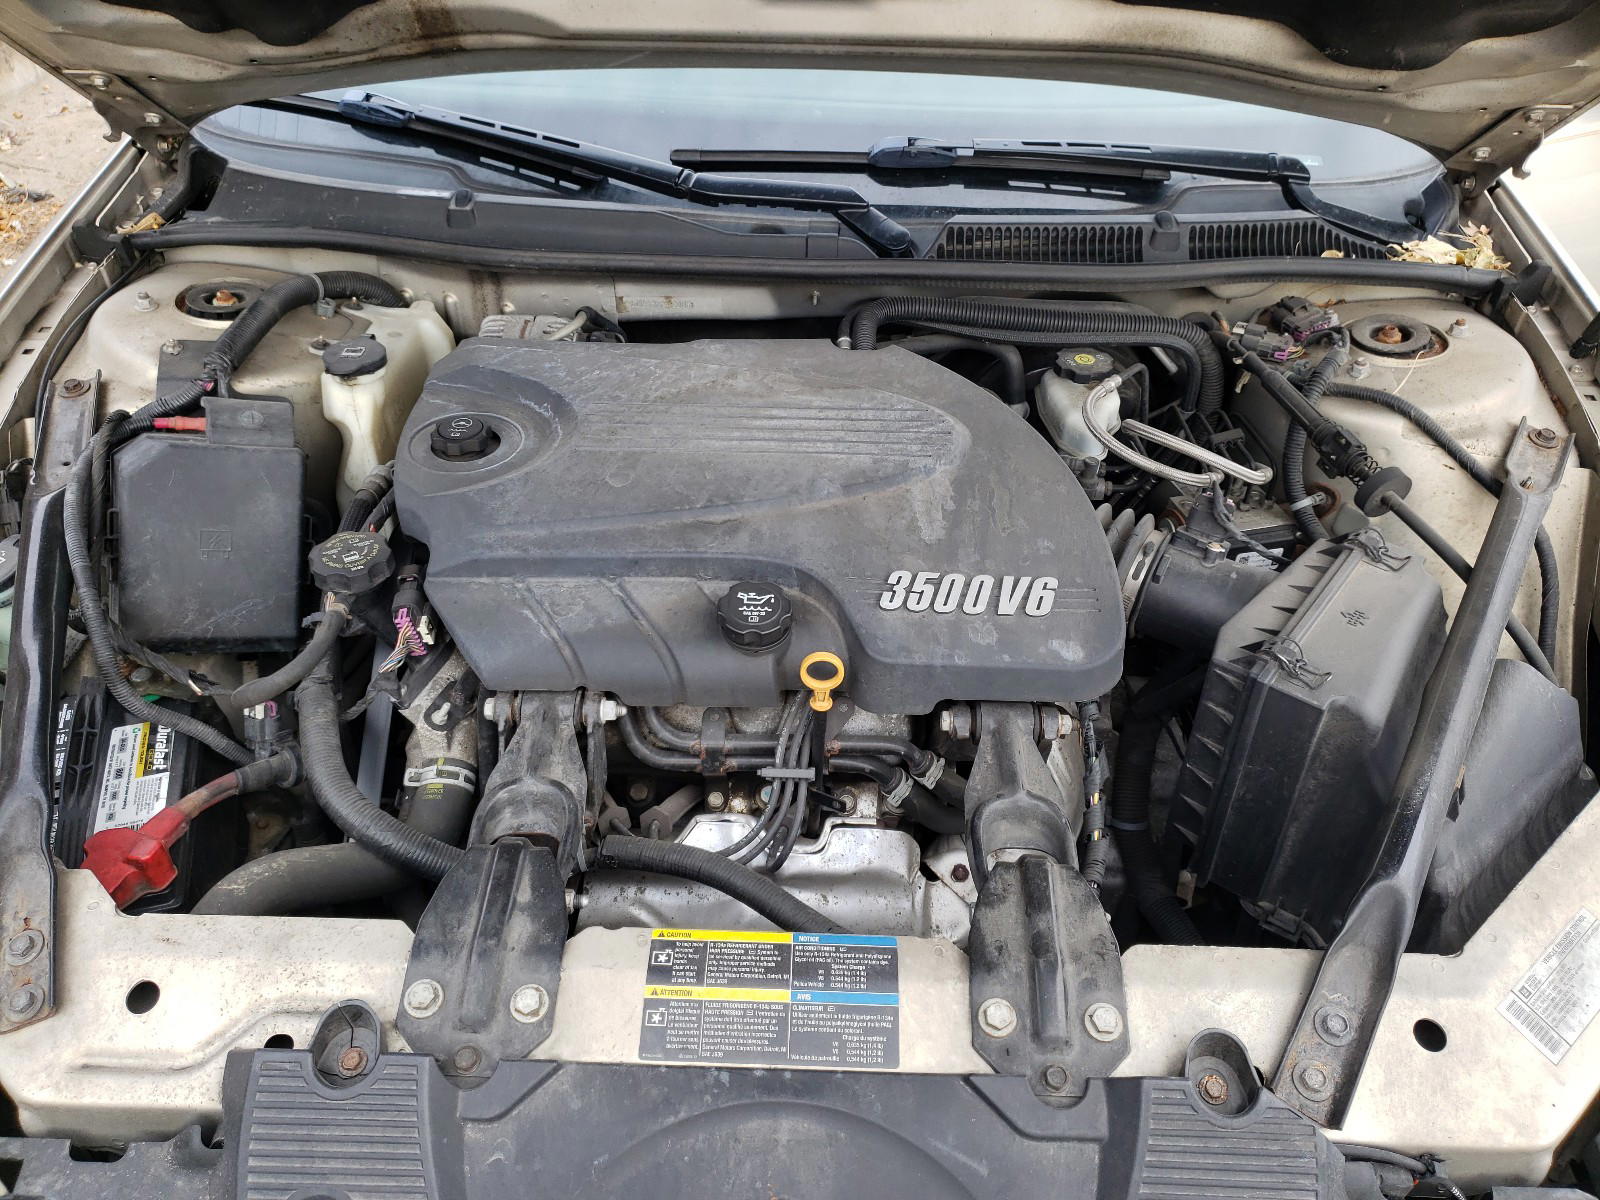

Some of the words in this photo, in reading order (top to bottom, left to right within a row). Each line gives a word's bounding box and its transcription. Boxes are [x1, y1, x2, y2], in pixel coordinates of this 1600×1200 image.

[879, 570, 994, 615] 3500
[997, 575, 1058, 617] V6
[153, 724, 172, 770] Duralast
